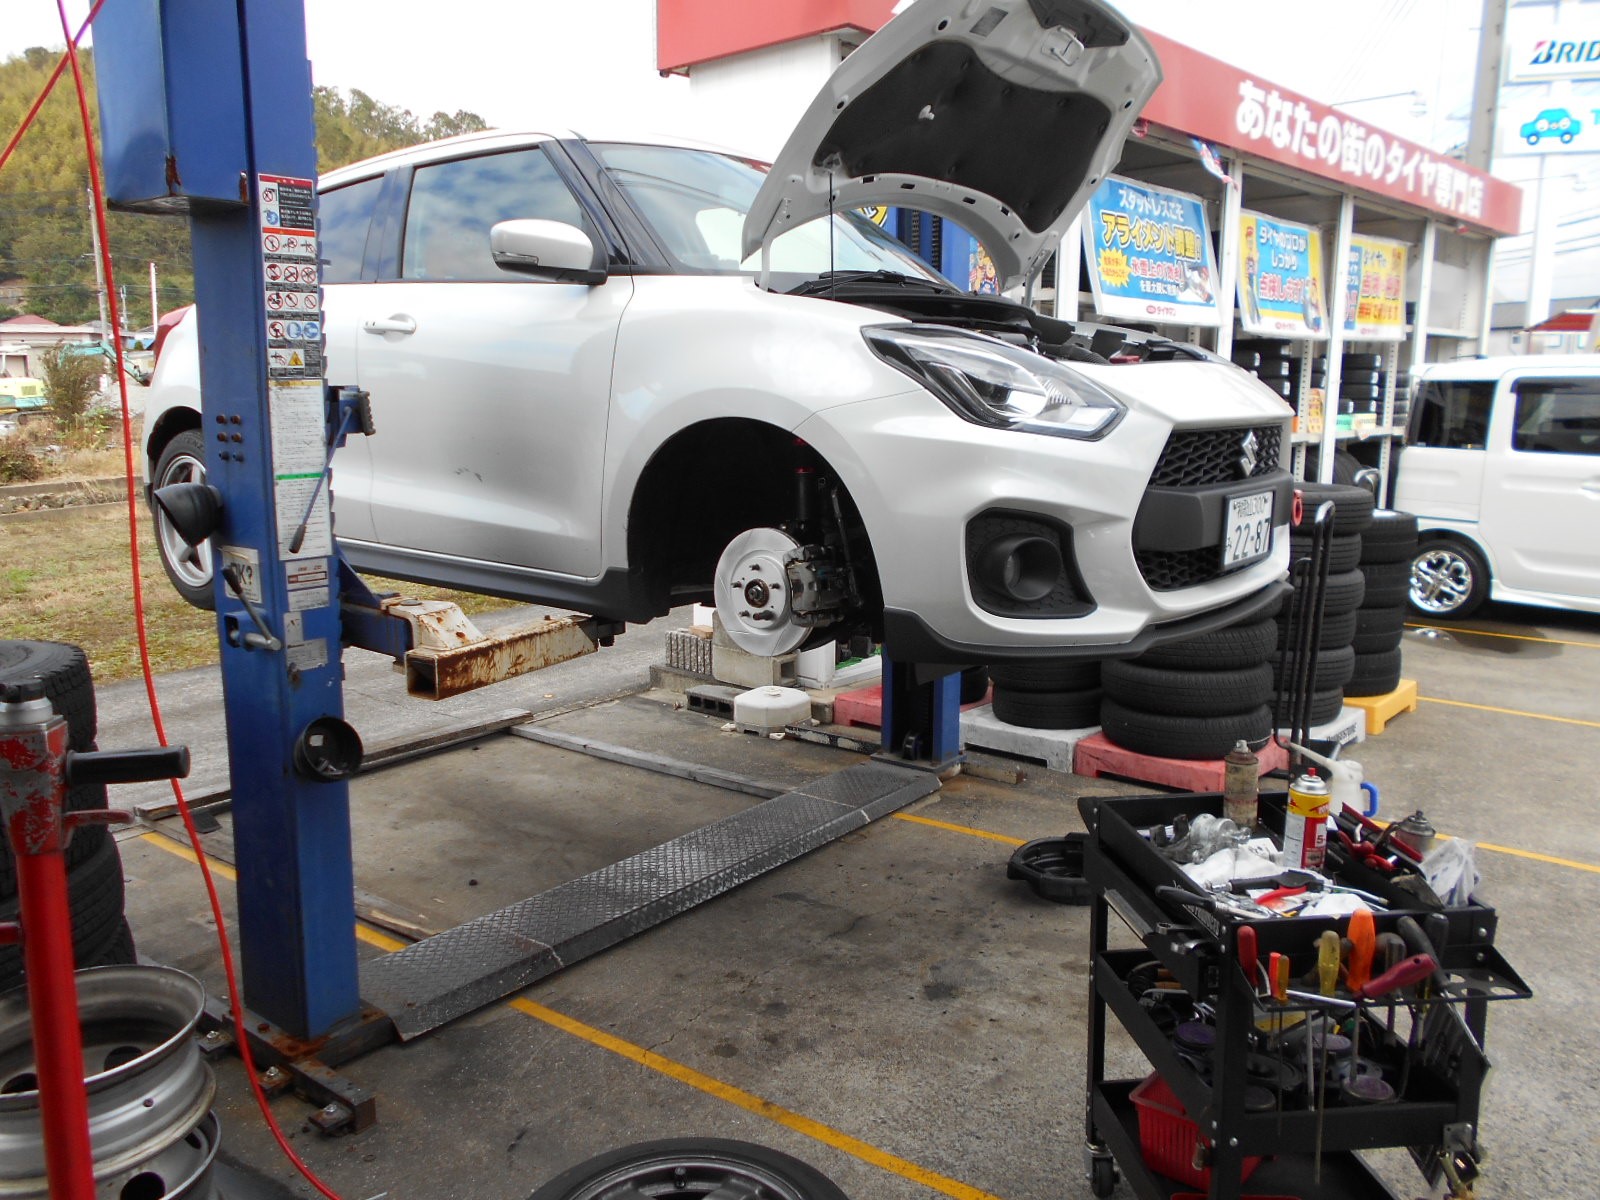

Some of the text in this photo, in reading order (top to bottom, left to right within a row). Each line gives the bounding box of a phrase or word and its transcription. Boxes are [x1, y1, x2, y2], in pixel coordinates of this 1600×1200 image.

[1235, 80, 1484, 220] あなたの街のタイヤ専門店
